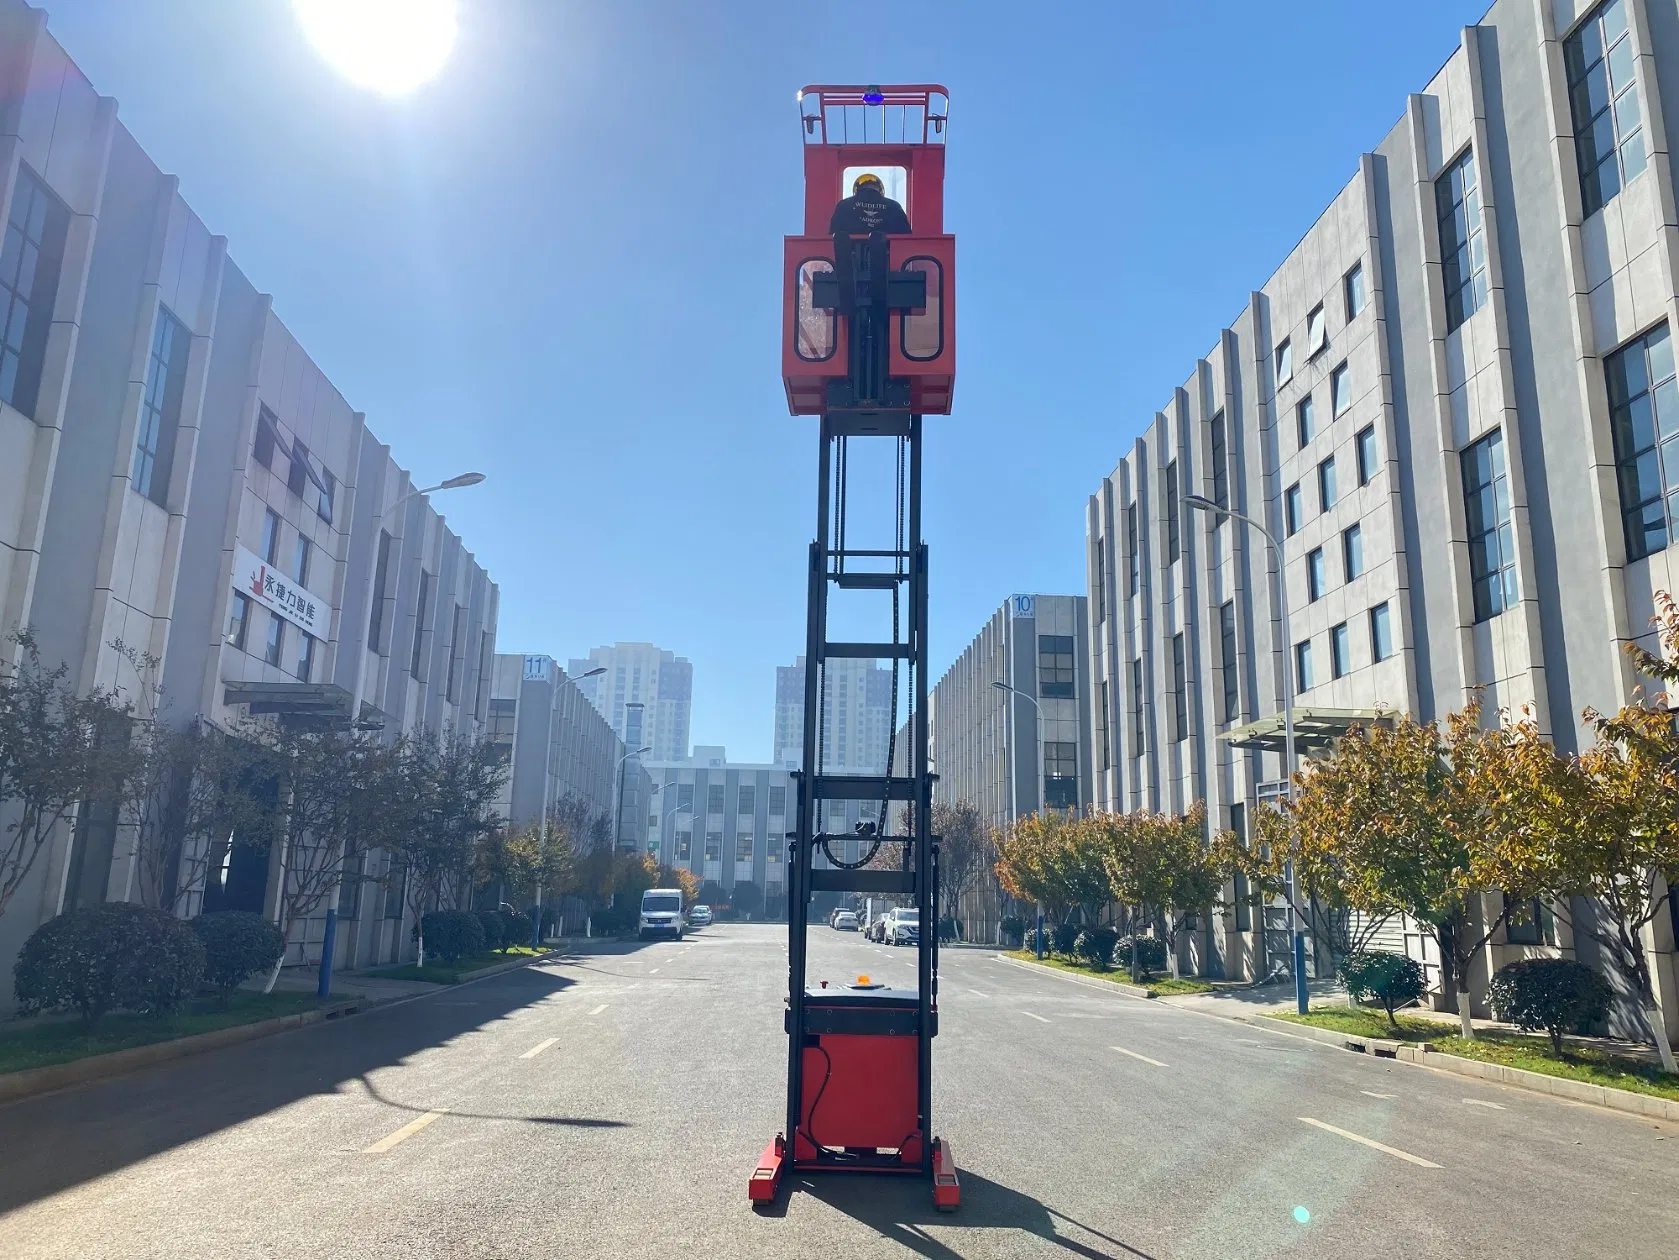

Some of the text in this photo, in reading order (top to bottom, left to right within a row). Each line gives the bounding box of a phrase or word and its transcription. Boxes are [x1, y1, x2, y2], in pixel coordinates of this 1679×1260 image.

[264, 574, 316, 620] 永捷力智能
